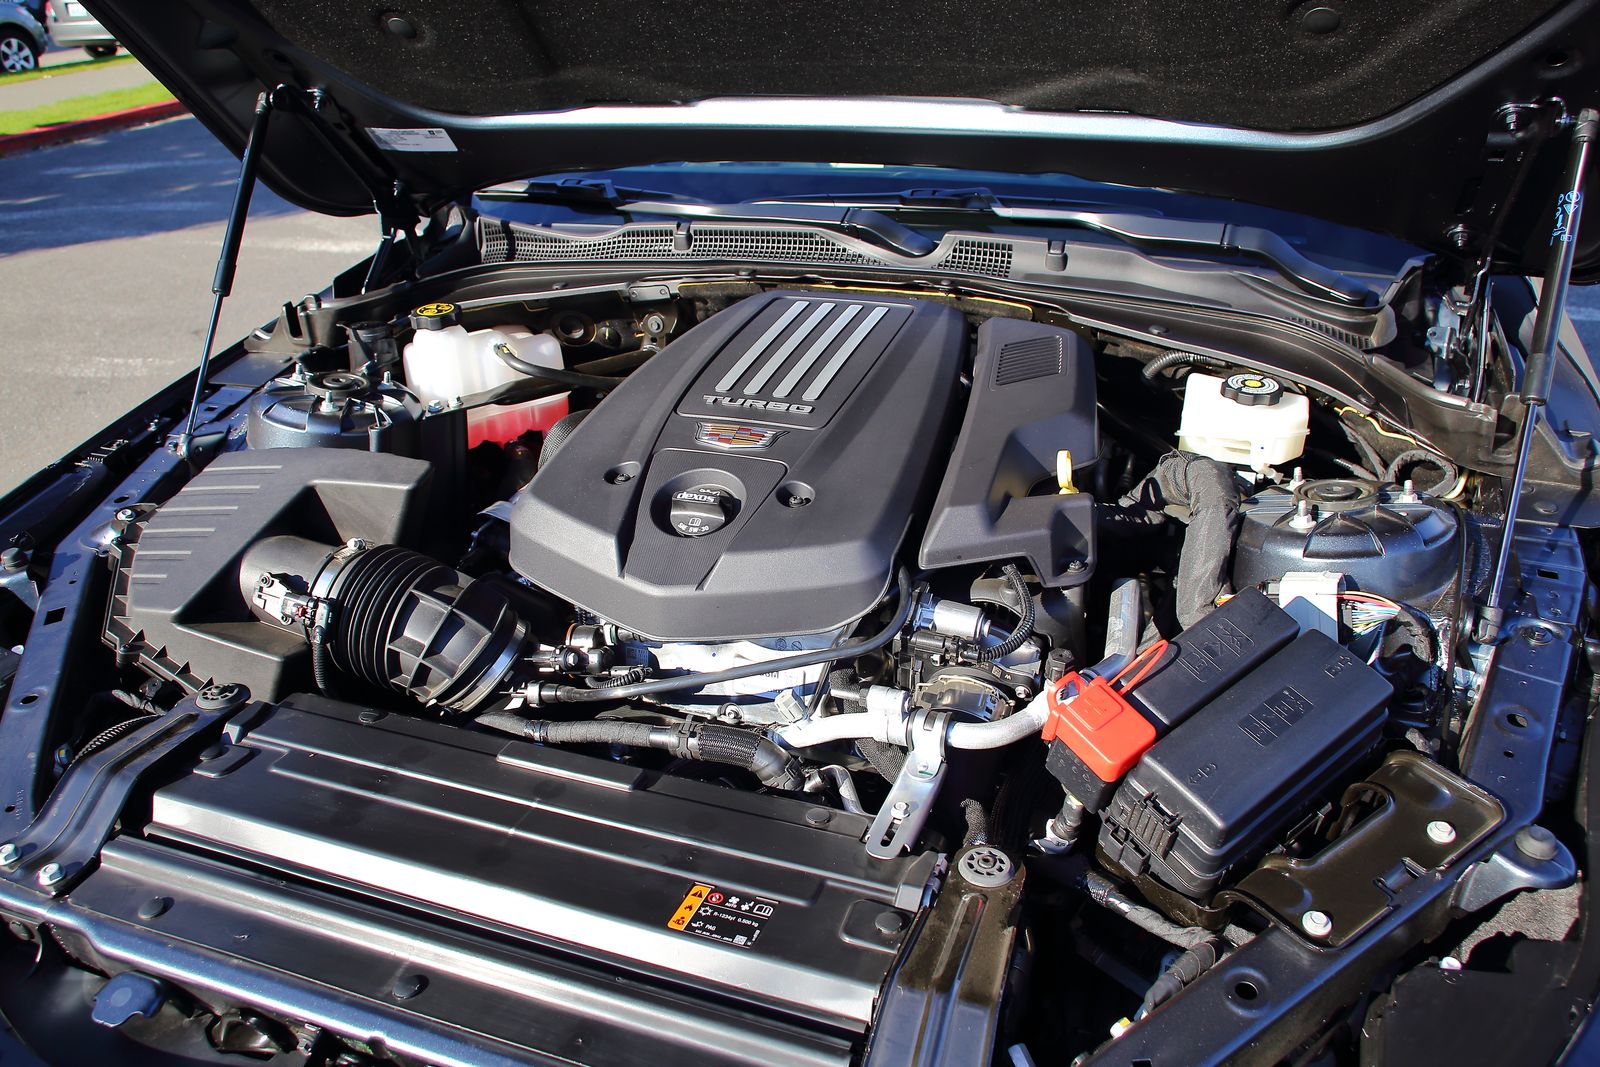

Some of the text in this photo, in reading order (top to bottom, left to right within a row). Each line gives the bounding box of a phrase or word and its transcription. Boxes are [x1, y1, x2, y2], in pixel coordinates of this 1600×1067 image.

[703, 395, 815, 414] TURBO
[676, 491, 716, 503] dexos
[678, 522, 710, 533] SAE 5W-30
